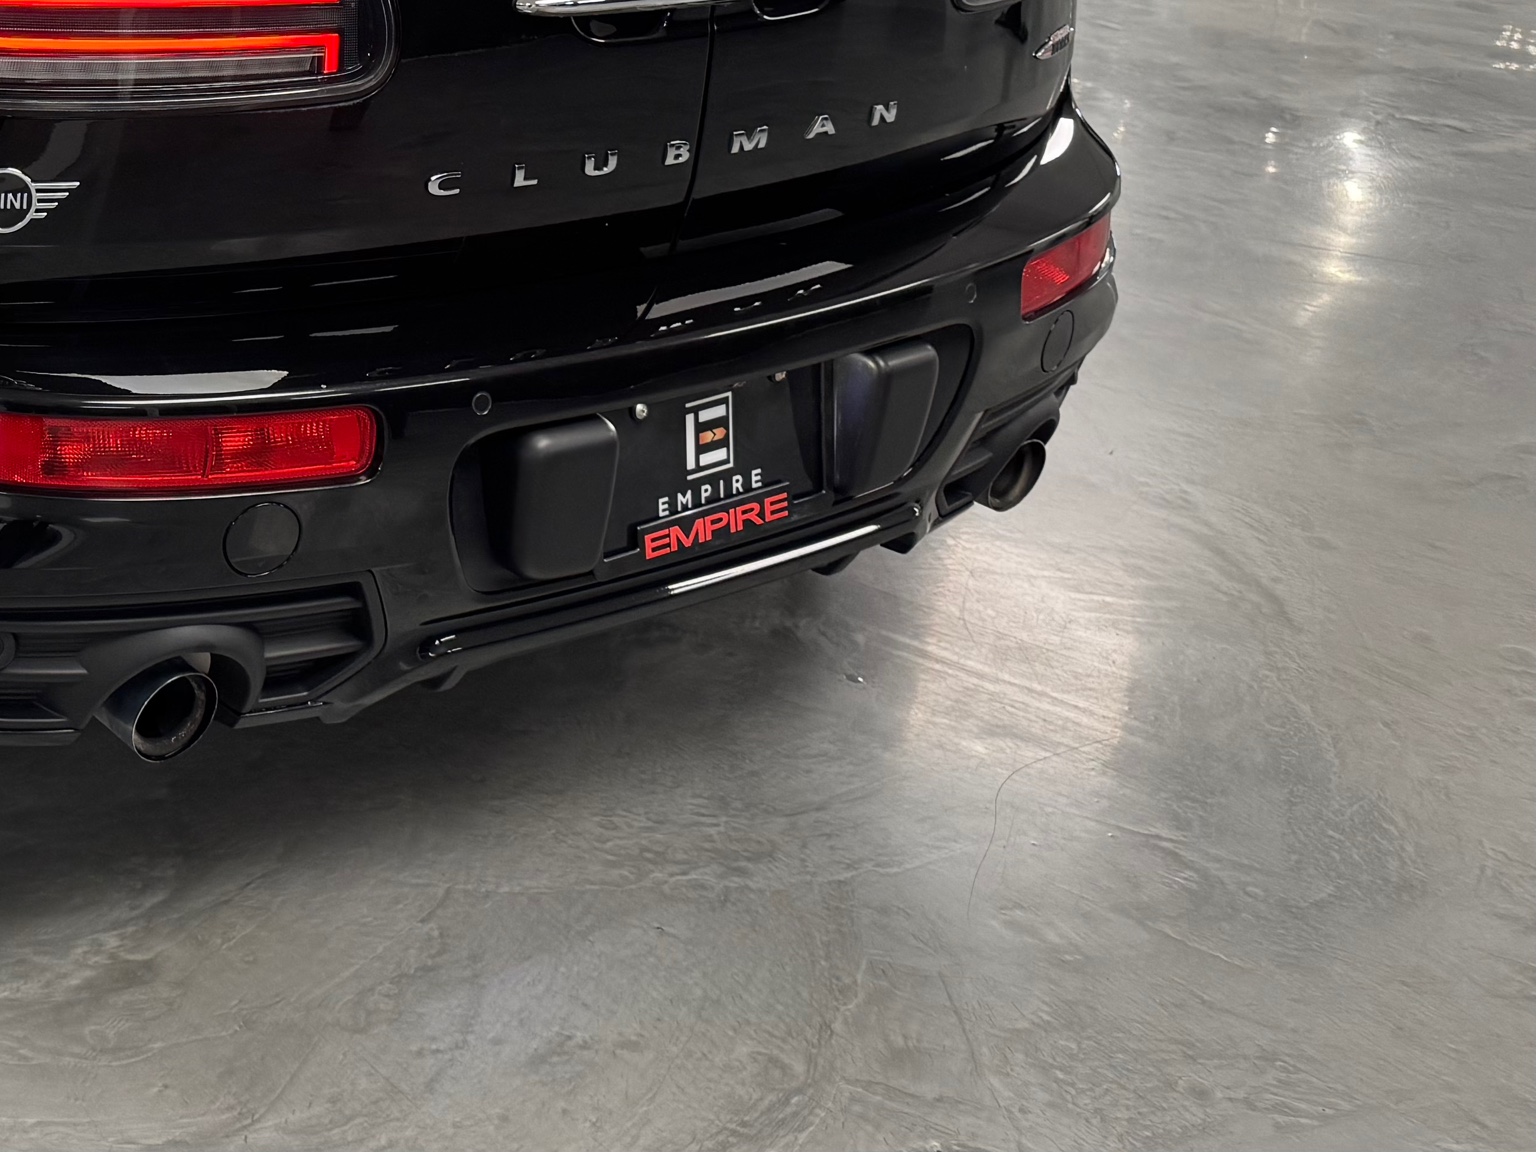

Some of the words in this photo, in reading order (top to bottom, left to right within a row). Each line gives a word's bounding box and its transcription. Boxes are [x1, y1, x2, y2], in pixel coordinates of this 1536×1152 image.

[427, 100, 898, 197] CLUBMAN
[644, 492, 789, 560] EMPIRE
[657, 468, 763, 517] EMPIRE
